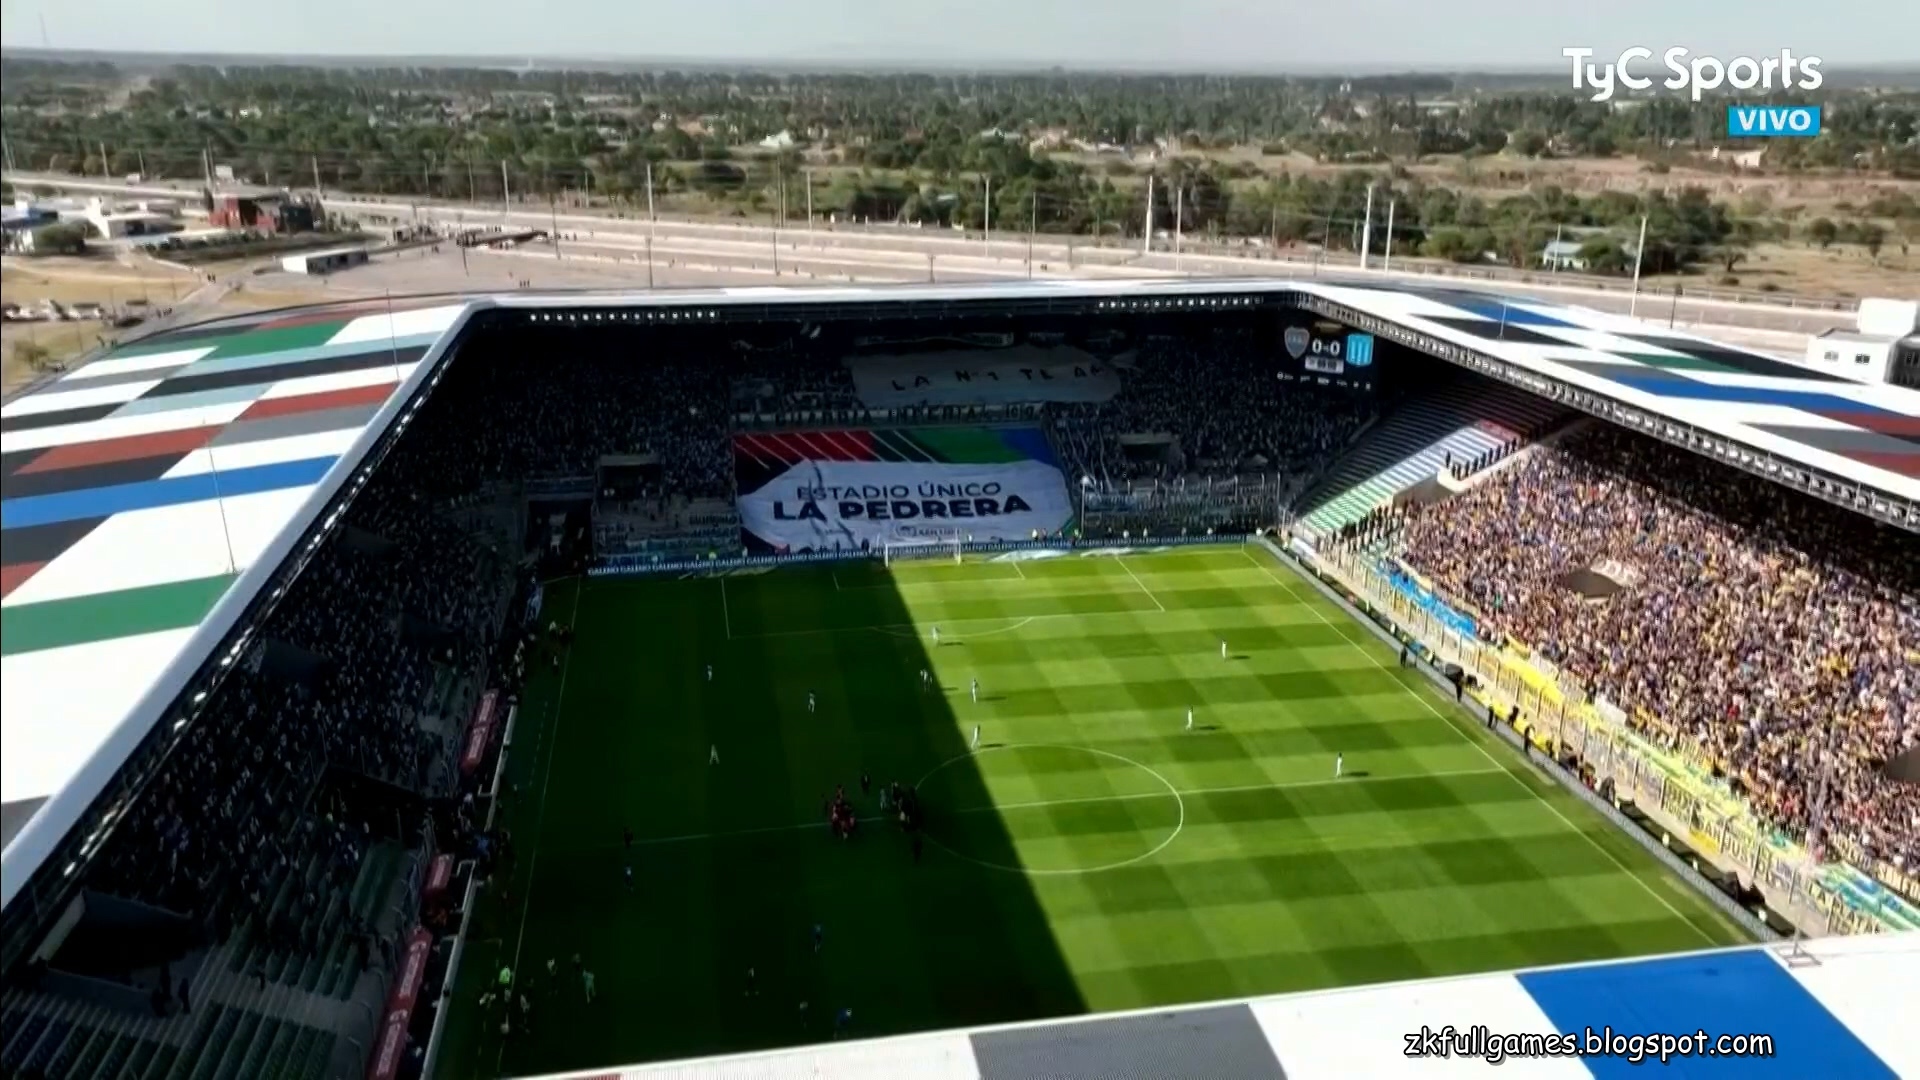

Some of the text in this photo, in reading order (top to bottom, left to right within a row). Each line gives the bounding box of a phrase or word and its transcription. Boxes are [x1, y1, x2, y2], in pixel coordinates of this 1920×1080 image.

[796, 480, 1001, 502] ESTADIO ÚNICO
[774, 494, 1033, 522] LA PEDRERA
